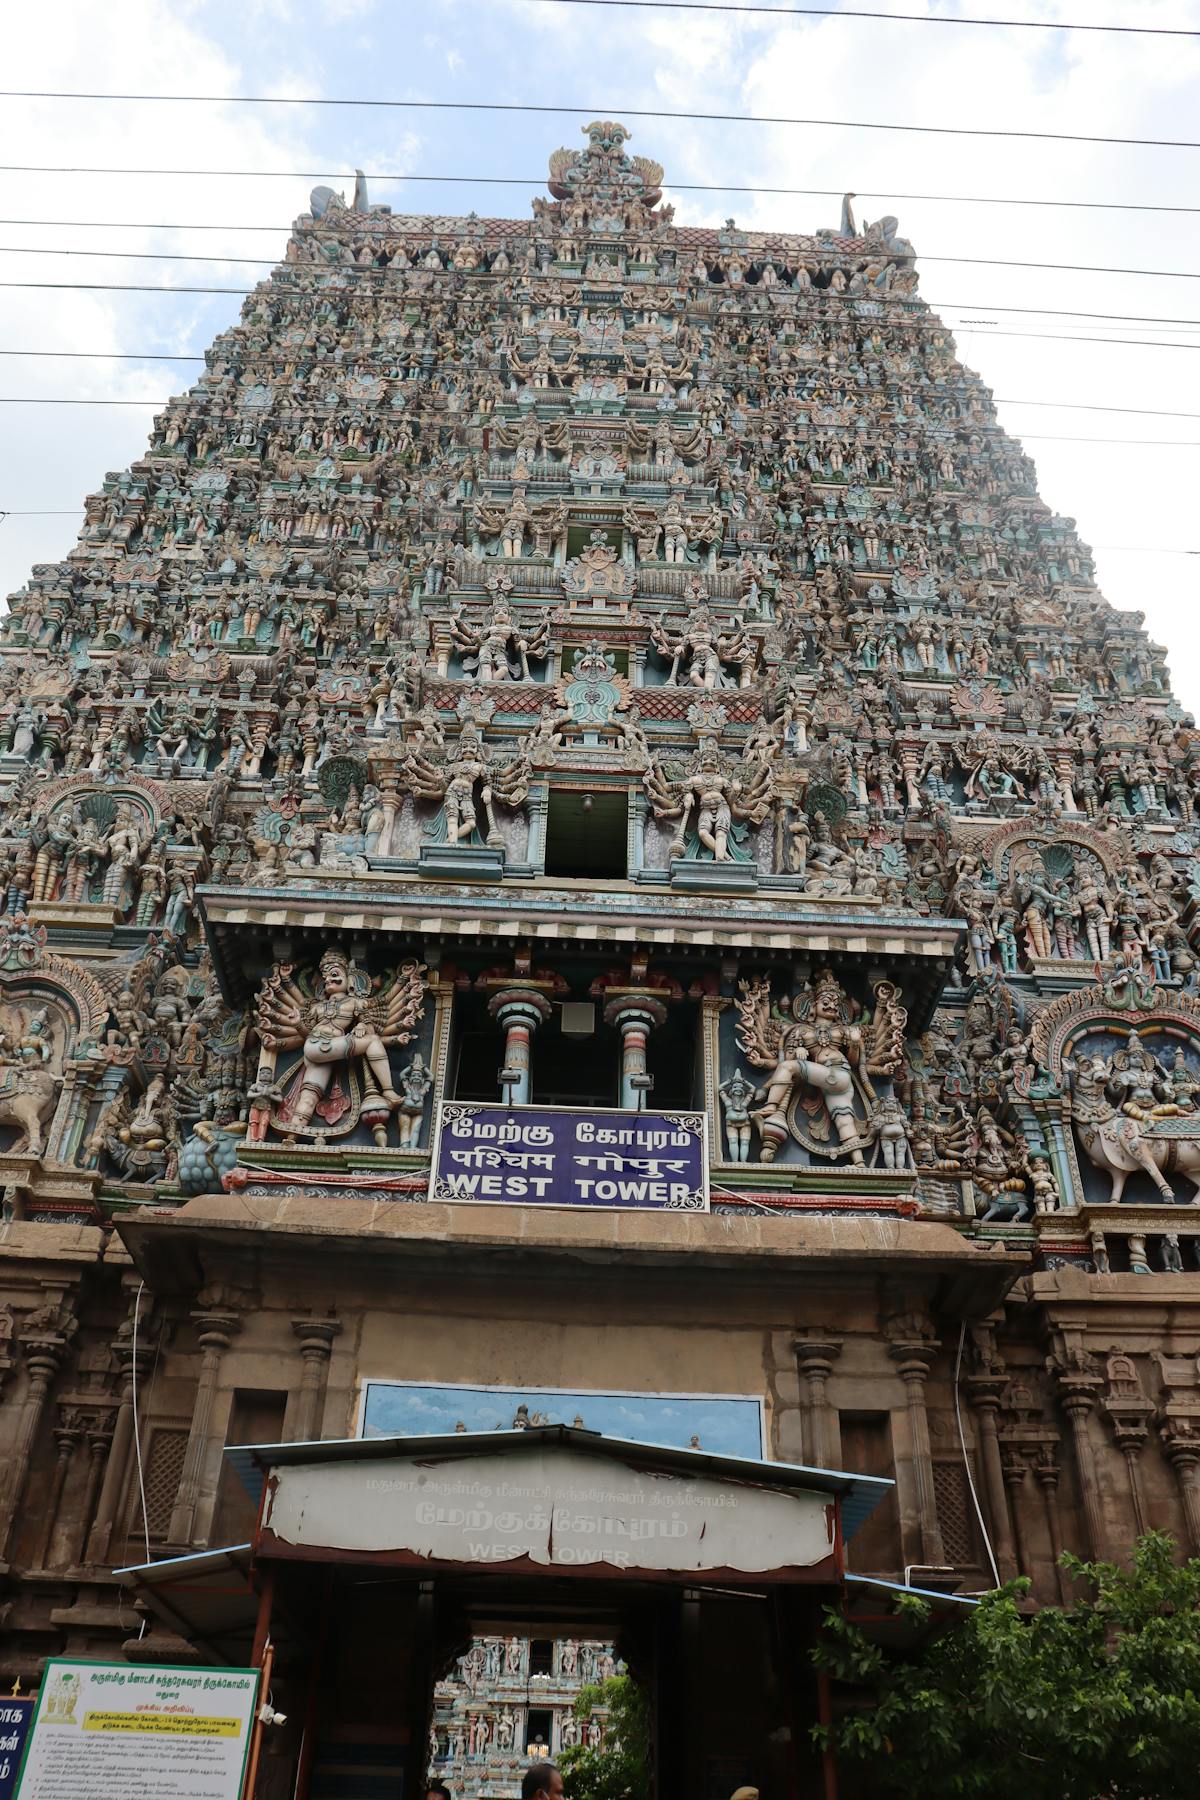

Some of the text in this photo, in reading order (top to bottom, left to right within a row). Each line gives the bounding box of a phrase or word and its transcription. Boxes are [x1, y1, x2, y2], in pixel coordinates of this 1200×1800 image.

[451, 1118, 692, 1151] மேற்கு கோபுரம்
[450, 1146, 691, 1178] पश्चिम गोपुर
[446, 1173, 692, 1202] WEST TOWER
